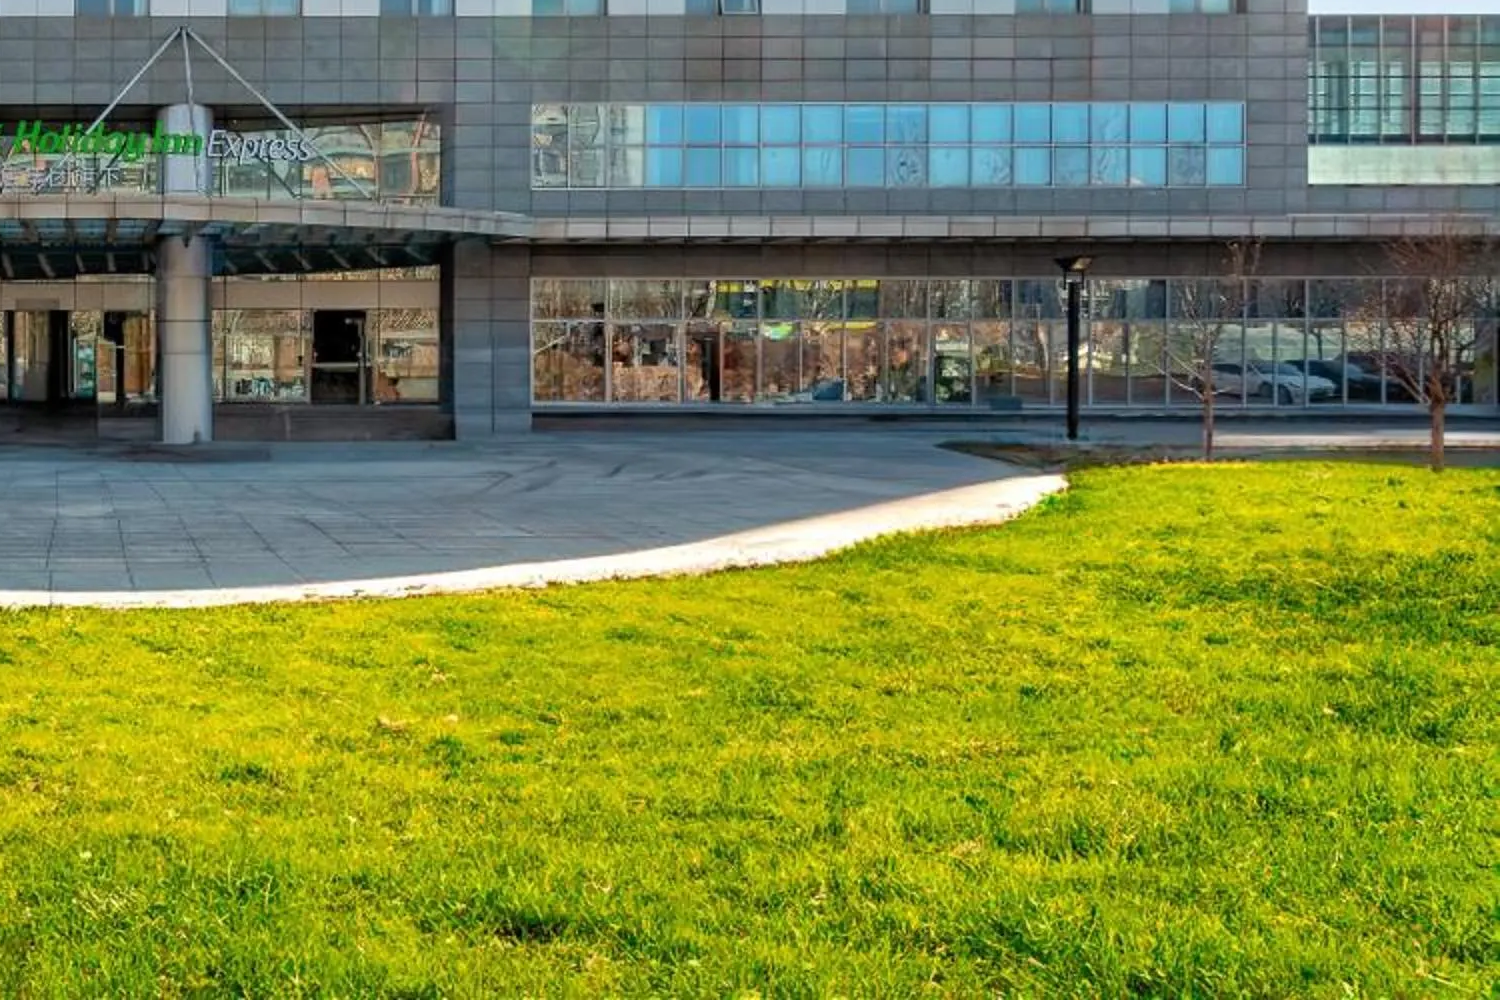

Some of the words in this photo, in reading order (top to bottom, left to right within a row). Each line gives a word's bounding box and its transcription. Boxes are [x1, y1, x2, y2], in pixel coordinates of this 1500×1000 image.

[11, 120, 149, 163] Holiday
[150, 120, 203, 156] Inn
[207, 129, 312, 166] Express
